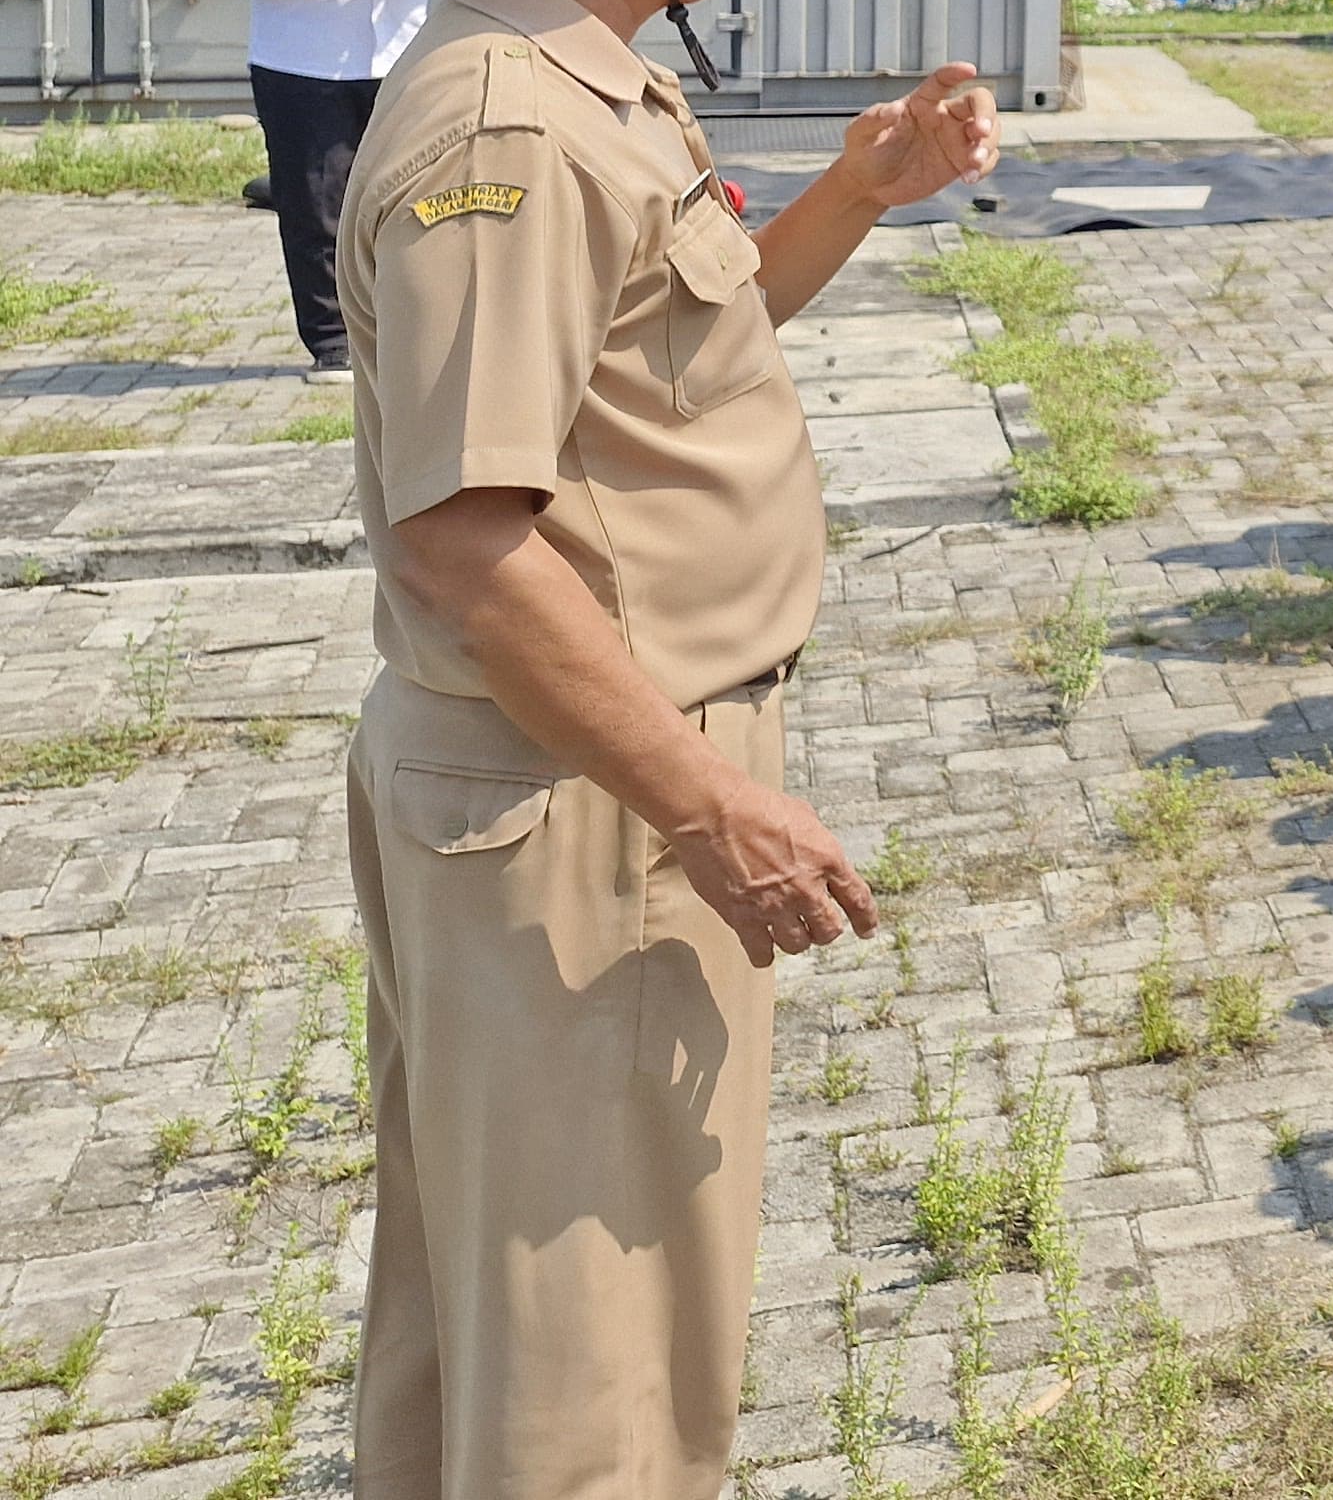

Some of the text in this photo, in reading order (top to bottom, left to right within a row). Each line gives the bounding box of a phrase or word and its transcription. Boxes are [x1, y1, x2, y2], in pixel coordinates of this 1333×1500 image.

[425, 186, 512, 210] KEMENTRIAN
[425, 196, 513, 220] DALAM NEGERI
